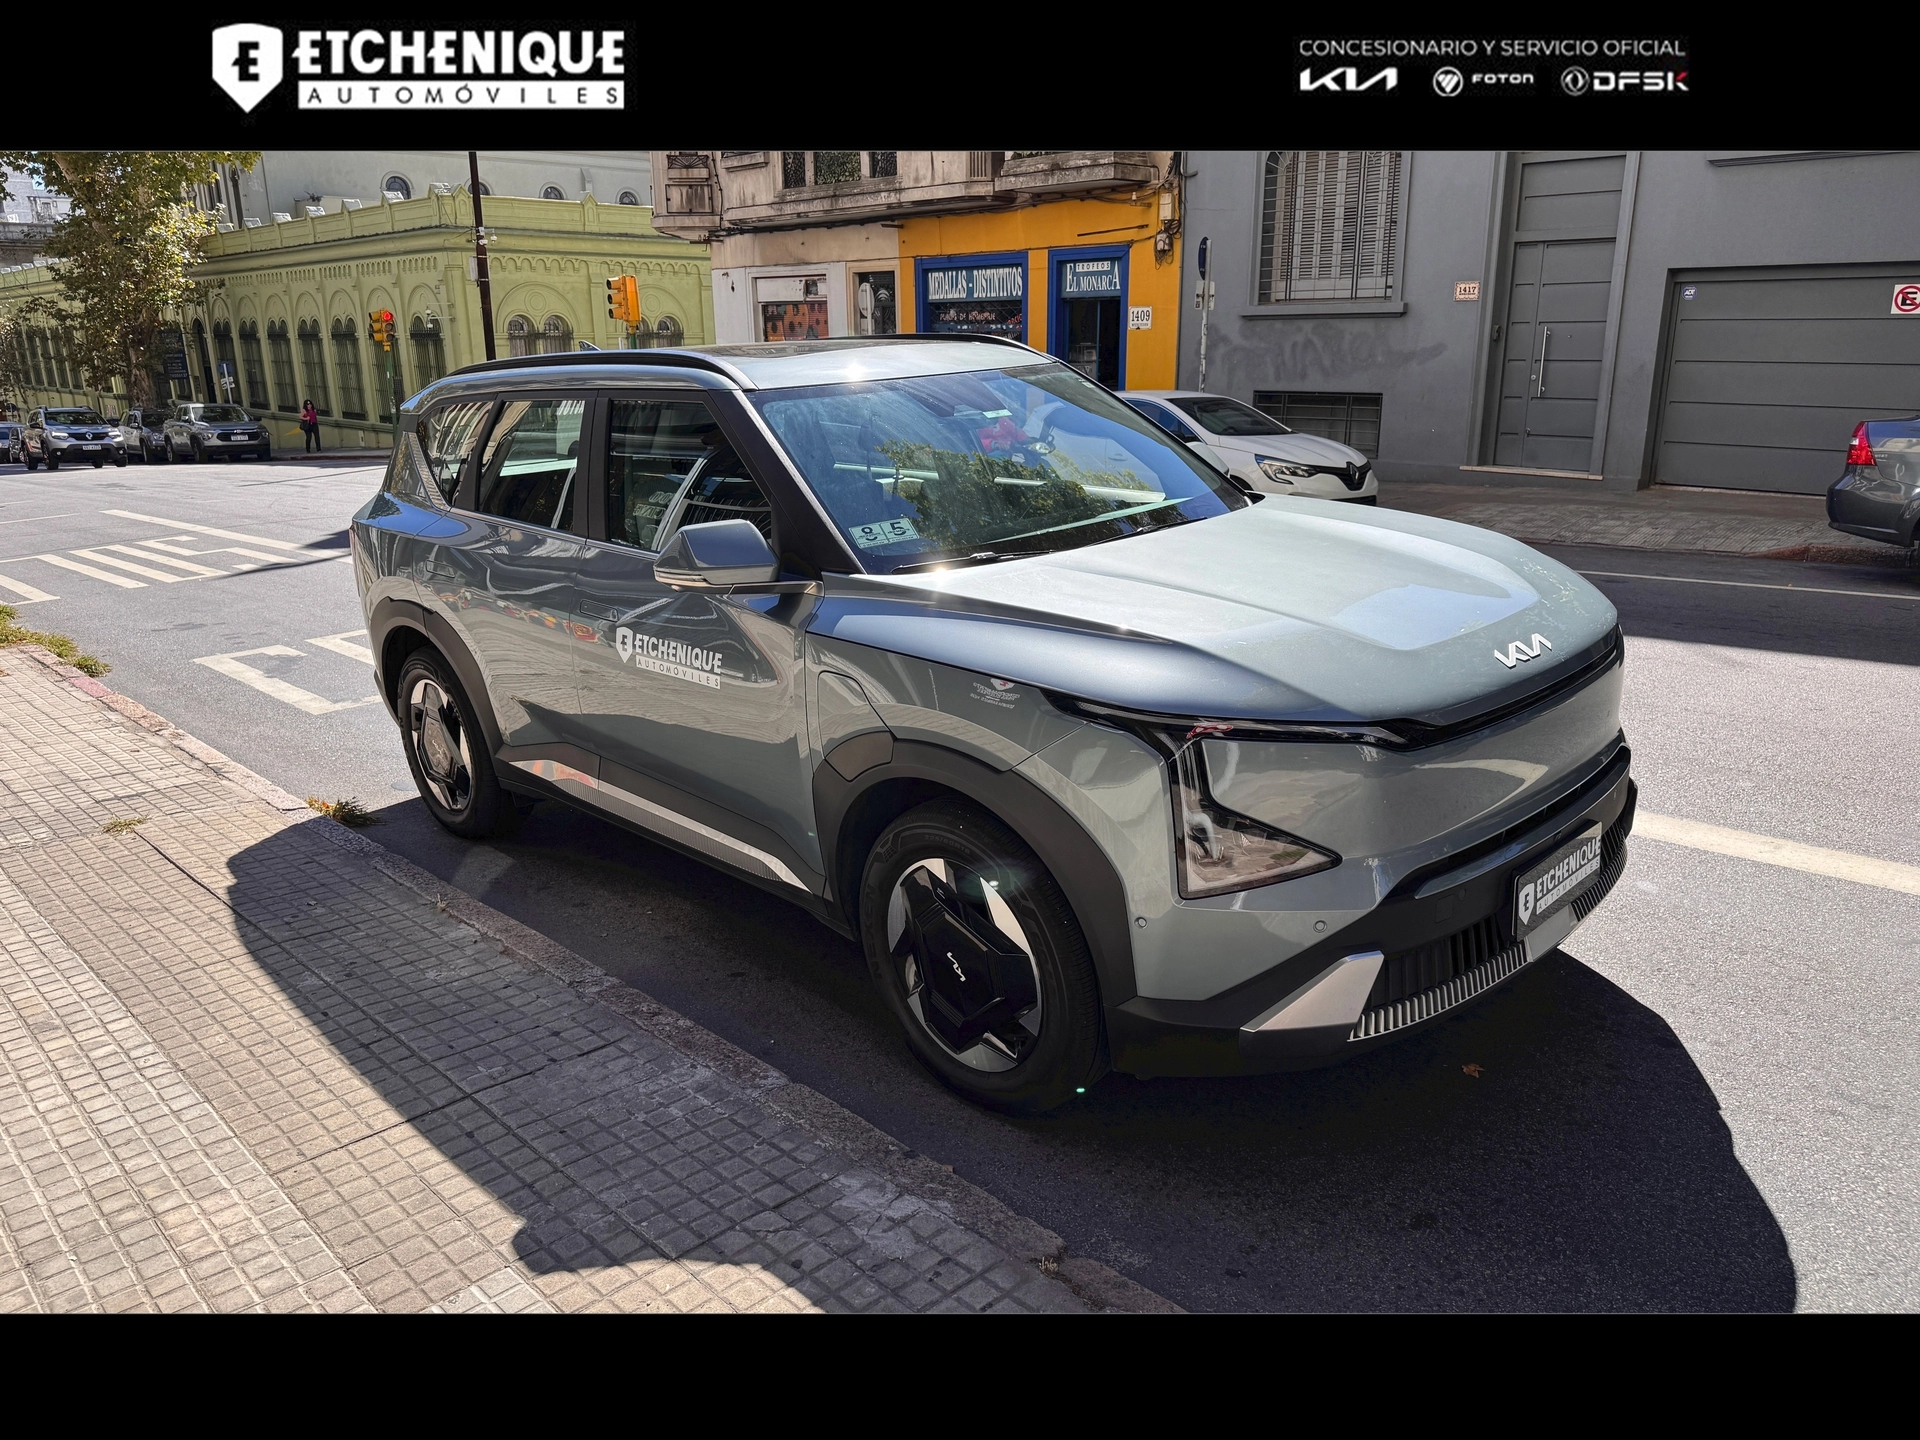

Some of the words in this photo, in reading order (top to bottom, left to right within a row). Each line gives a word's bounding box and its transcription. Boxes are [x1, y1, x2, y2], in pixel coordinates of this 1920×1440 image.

[1077, 262, 1110, 270] TROFEOS
[1079, 260, 1121, 291] MONARCA
[928, 270, 967, 300] MEDALLAS
[973, 266, 1023, 298] DISTINTIVOS
[1131, 310, 1151, 322] 1409
[634, 633, 723, 675] ETCHENIQUE
[1536, 836, 1601, 900] ETCHENIQUE
